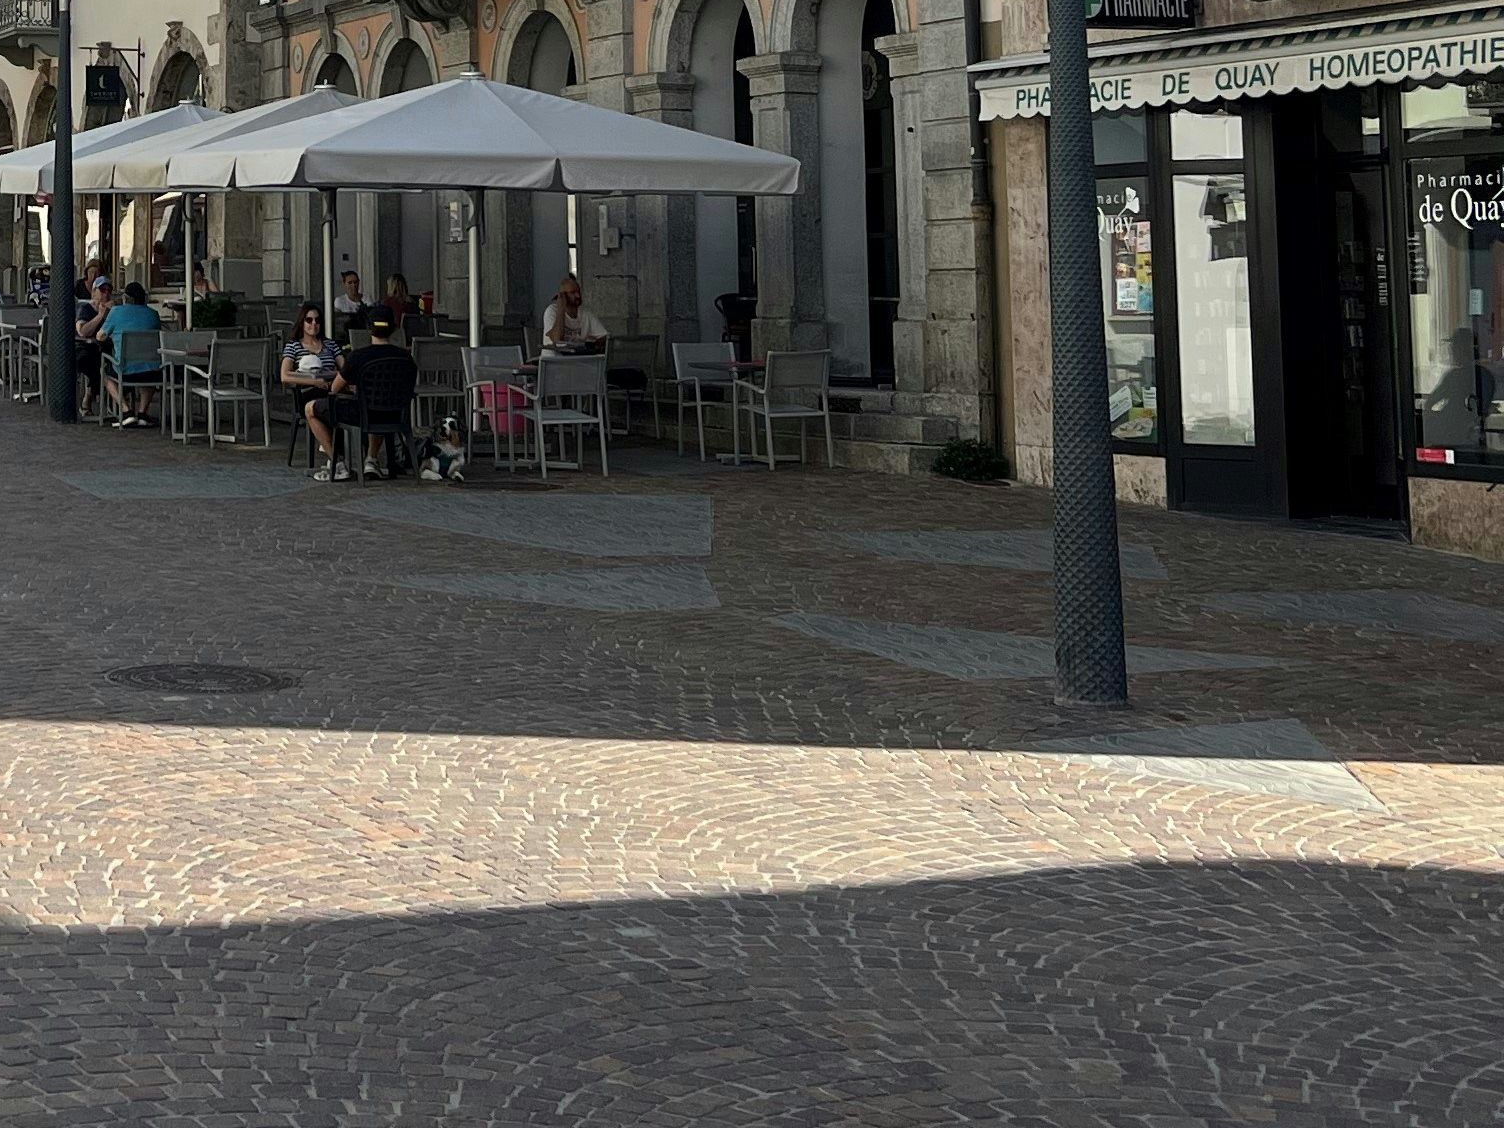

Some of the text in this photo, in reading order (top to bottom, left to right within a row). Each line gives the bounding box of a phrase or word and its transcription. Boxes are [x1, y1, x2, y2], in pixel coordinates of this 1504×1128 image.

[1016, 37, 1504, 109] PHAACIE DE QUAY HOMEOPATHIE
[1417, 173, 1501, 189] Pharmaci
[1419, 194, 1444, 223] de
